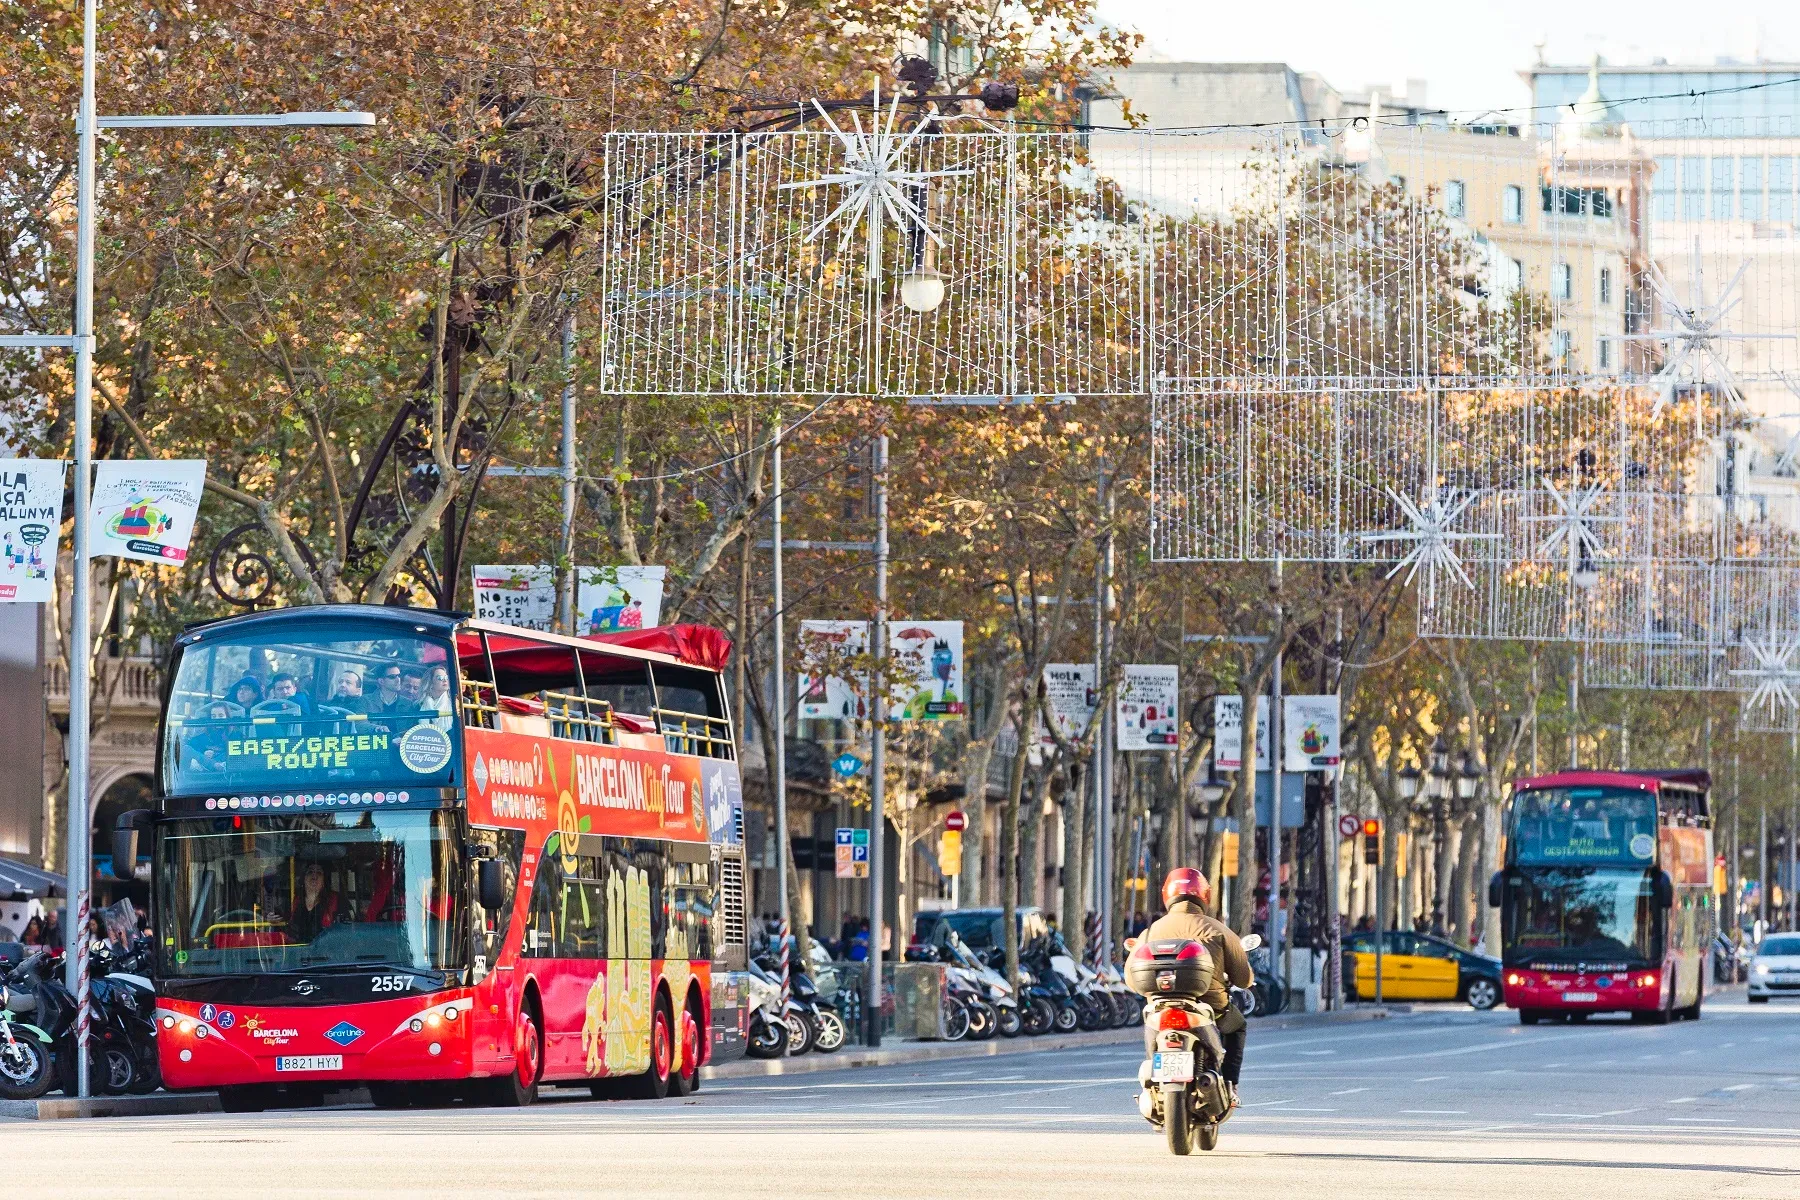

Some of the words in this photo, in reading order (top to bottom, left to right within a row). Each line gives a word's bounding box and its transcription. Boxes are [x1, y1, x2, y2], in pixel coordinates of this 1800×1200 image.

[0, 491, 26, 506] ÇA
[412, 735, 442, 743] OFFICIAL
[405, 744, 446, 753] BARCELONA
[267, 751, 348, 770] ROUTE
[839, 760, 855, 771] W
[575, 754, 647, 813] BARCELONA
[855, 847, 865, 860] P
[371, 975, 415, 992] 2557
[253, 1028, 299, 1038] BARCELONA
[284, 1058, 313, 1069] 8821
[317, 1057, 339, 1069] HYY
[1163, 1053, 1191, 1065] 2257
[1163, 1065, 1184, 1077] DRN
